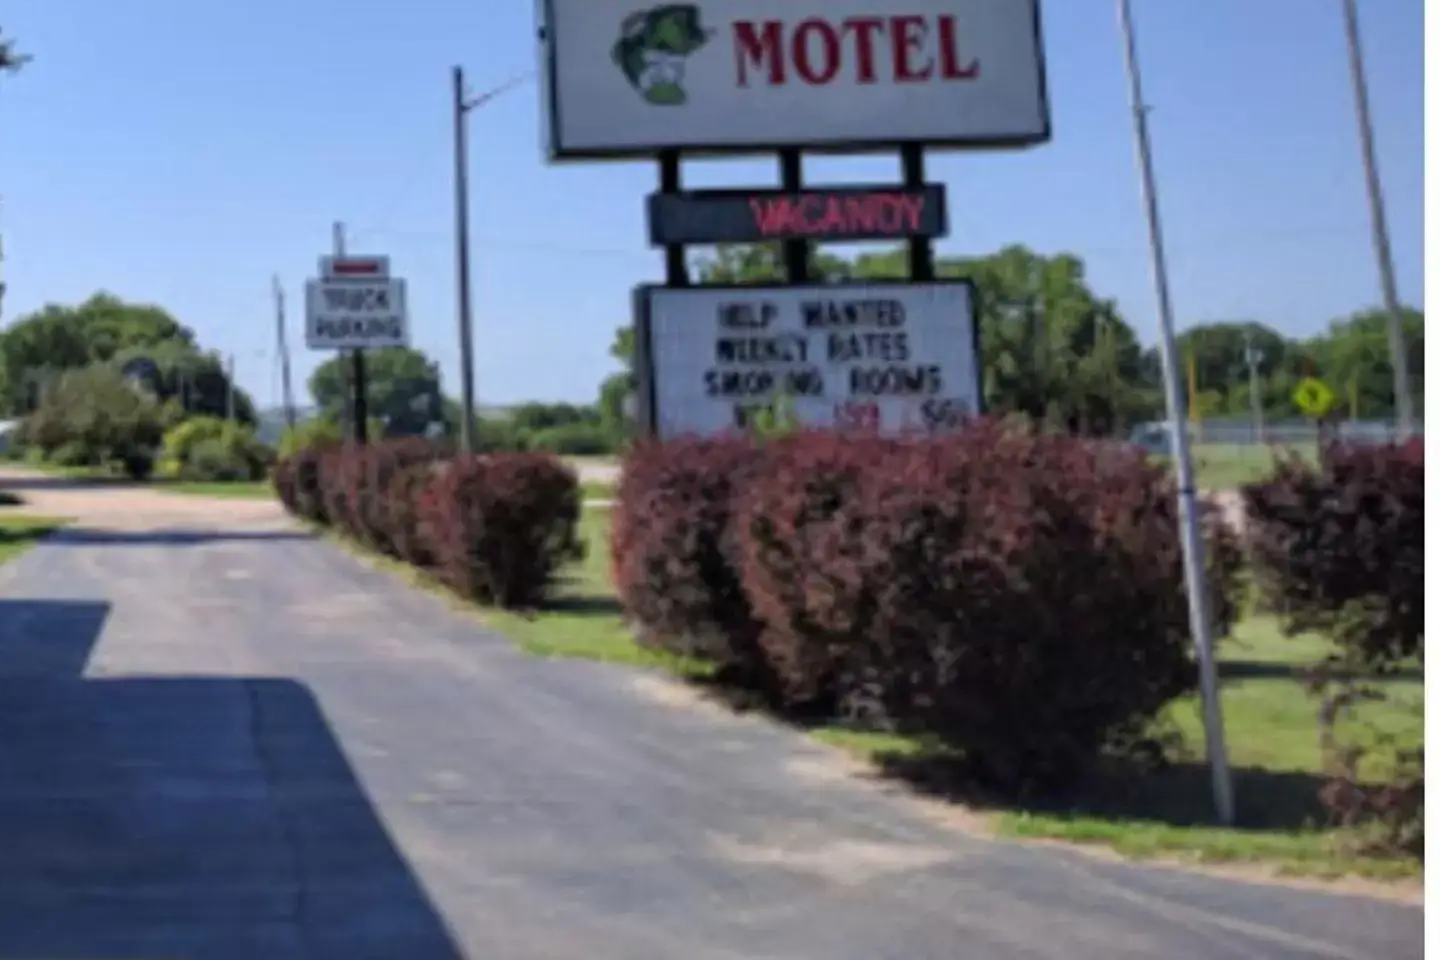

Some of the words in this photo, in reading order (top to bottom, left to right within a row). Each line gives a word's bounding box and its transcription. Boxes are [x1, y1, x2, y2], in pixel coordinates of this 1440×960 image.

[731, 13, 981, 88] MOTEL
[717, 302, 778, 328] HELP
[800, 298, 907, 329] WANTED
[826, 332, 910, 361] RATES
[703, 367, 824, 396] SMOKING
[849, 364, 942, 395] ROOMS
